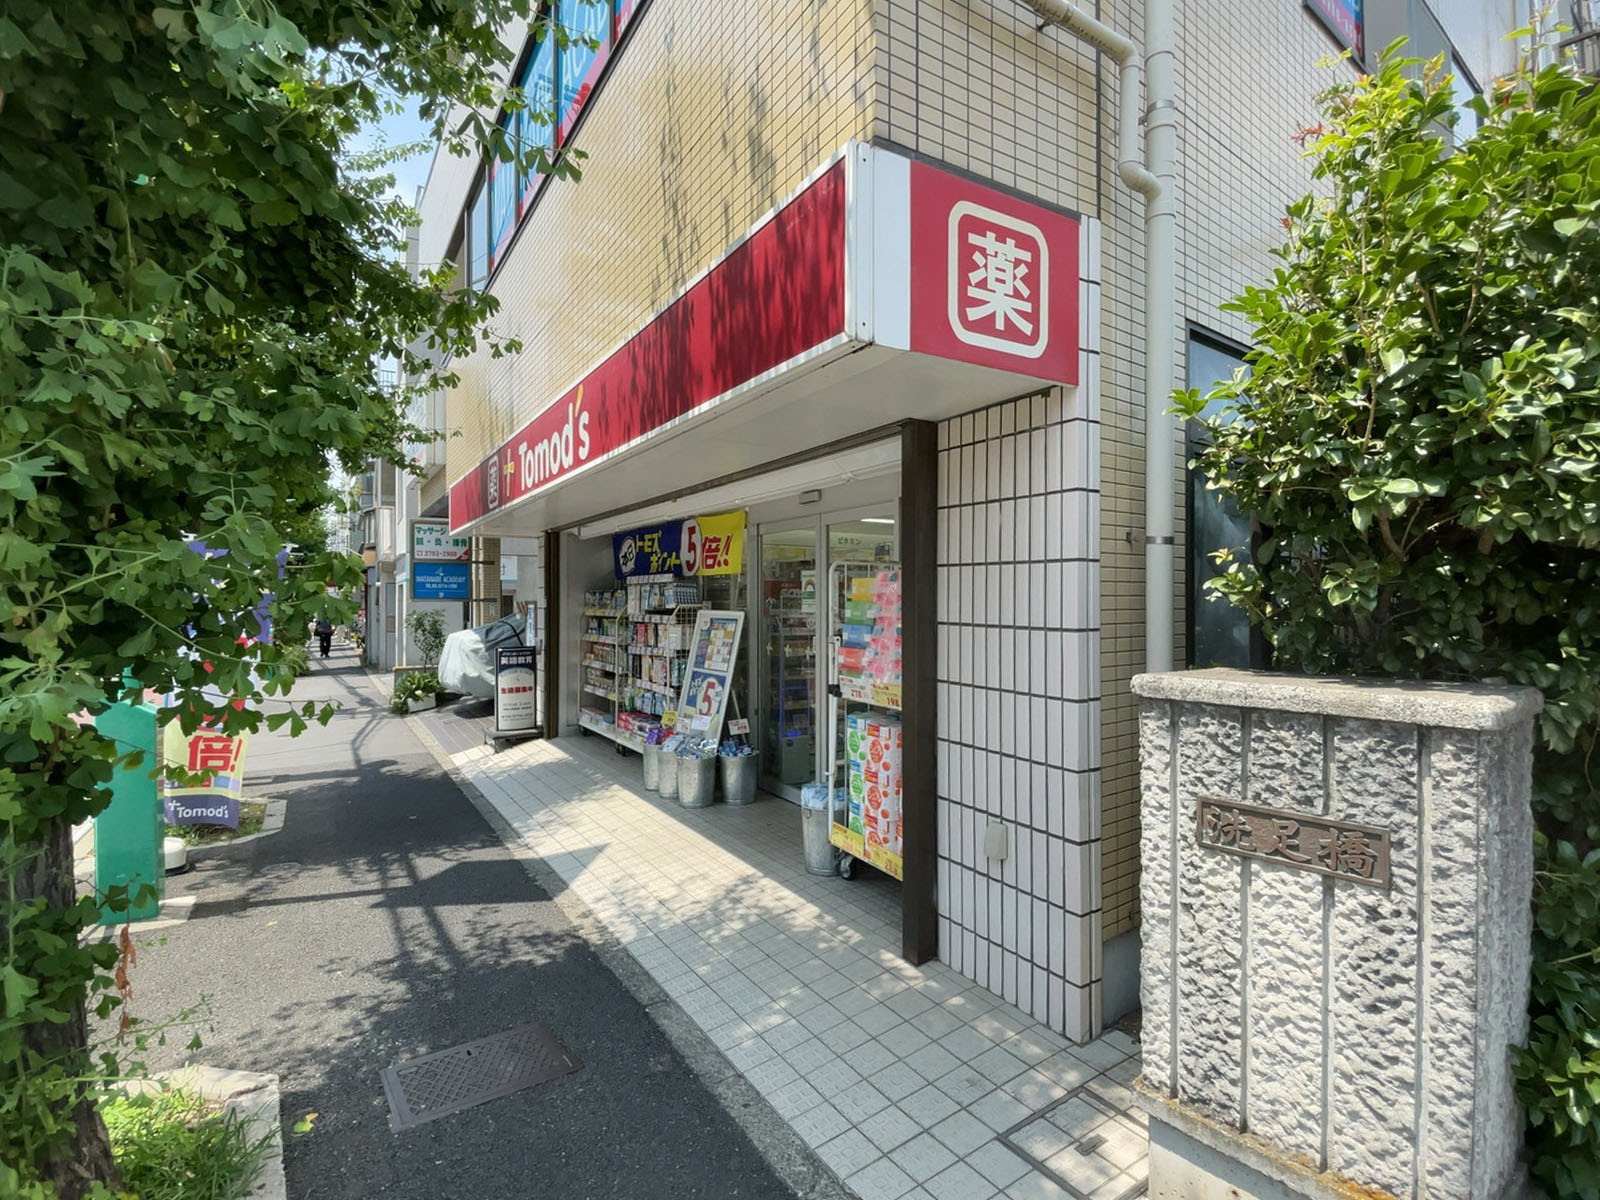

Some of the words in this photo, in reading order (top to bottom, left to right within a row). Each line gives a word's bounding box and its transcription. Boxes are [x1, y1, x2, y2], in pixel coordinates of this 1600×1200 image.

[965, 230, 1033, 337] 薬
[518, 384, 590, 492] Tomod's
[188, 735, 243, 772] 倍!
[177, 805, 229, 819] Tomod's
[1203, 806, 1379, 878] 洗足橋
